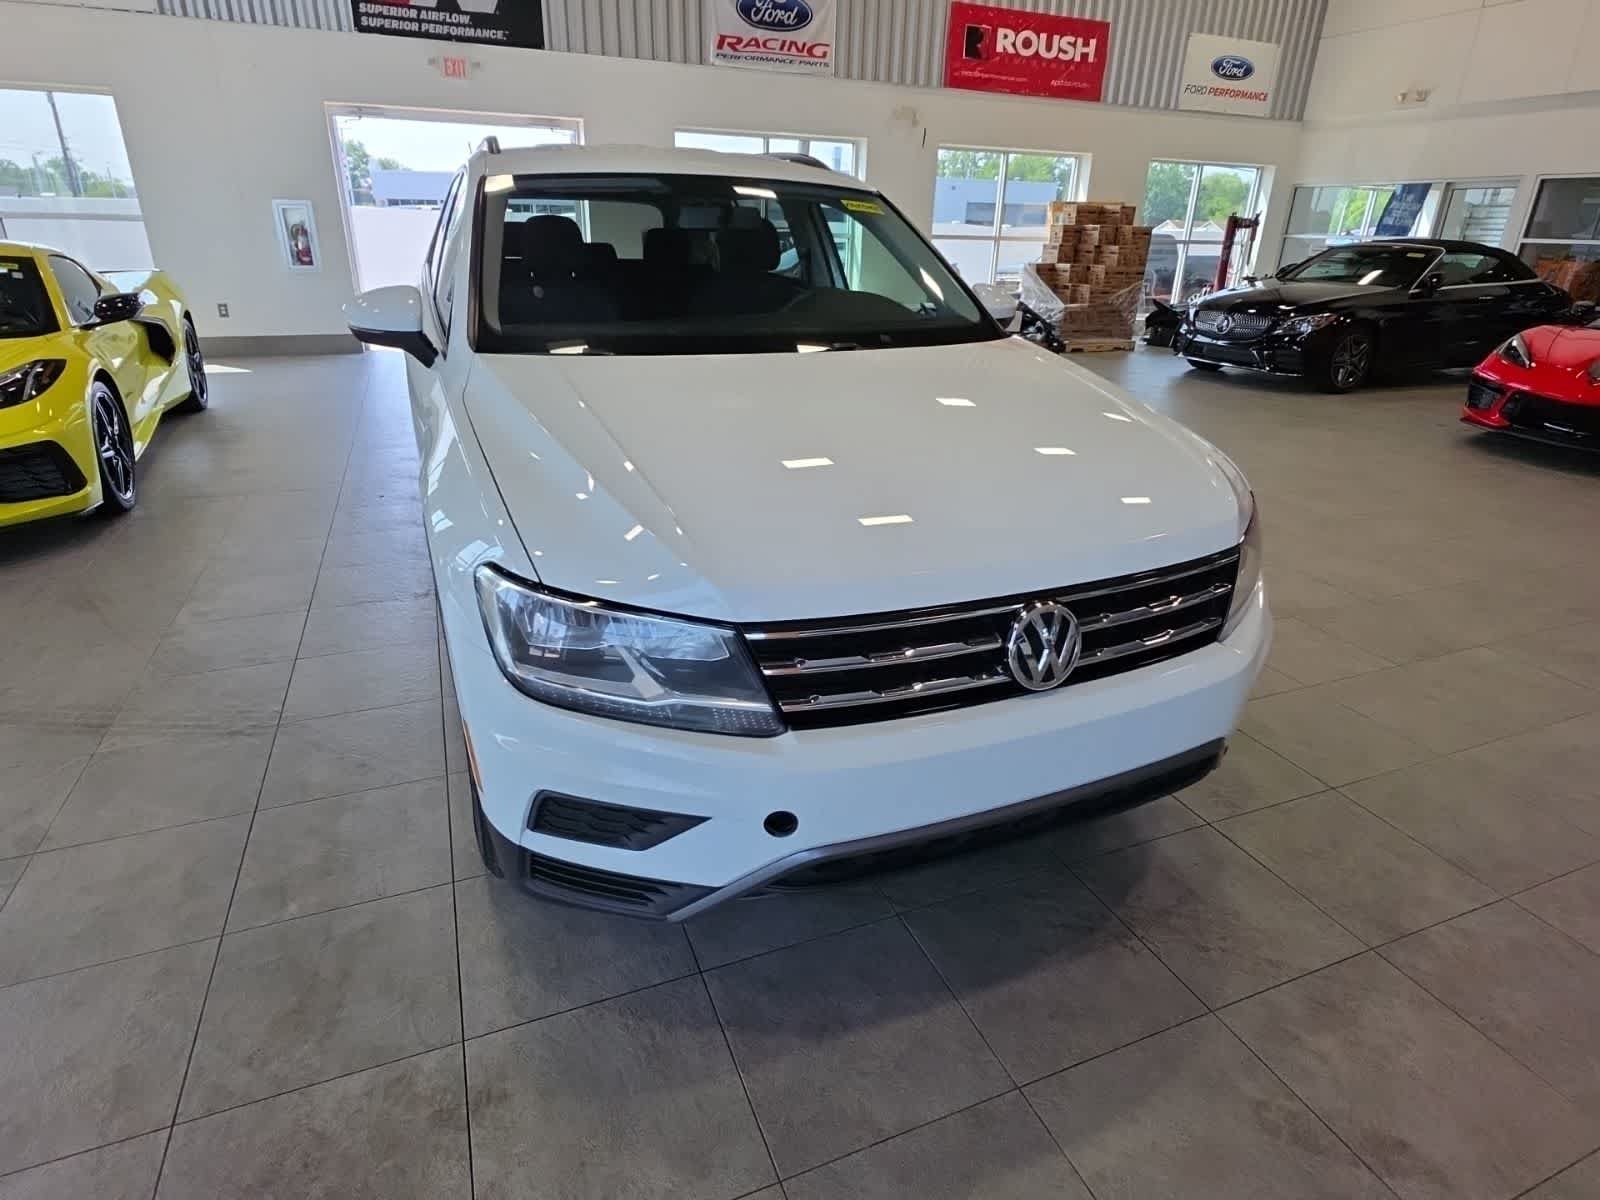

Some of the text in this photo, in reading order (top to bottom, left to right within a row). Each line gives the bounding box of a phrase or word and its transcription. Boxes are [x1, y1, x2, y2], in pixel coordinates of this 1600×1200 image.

[359, 2, 418, 19] SUPERIOR
[419, 10, 472, 25] AIRFLOW.
[751, 0, 799, 25] Ford
[360, 16, 419, 32] SUPERIOR
[716, 34, 830, 59] RACING
[996, 27, 1097, 63] ROUSH
[443, 57, 466, 78] EXIT
[716, 53, 830, 68] PERFORMANCE PARTS
[1219, 58, 1248, 77] Ford
[1184, 84, 1269, 102] FORD PERFORMANCE
